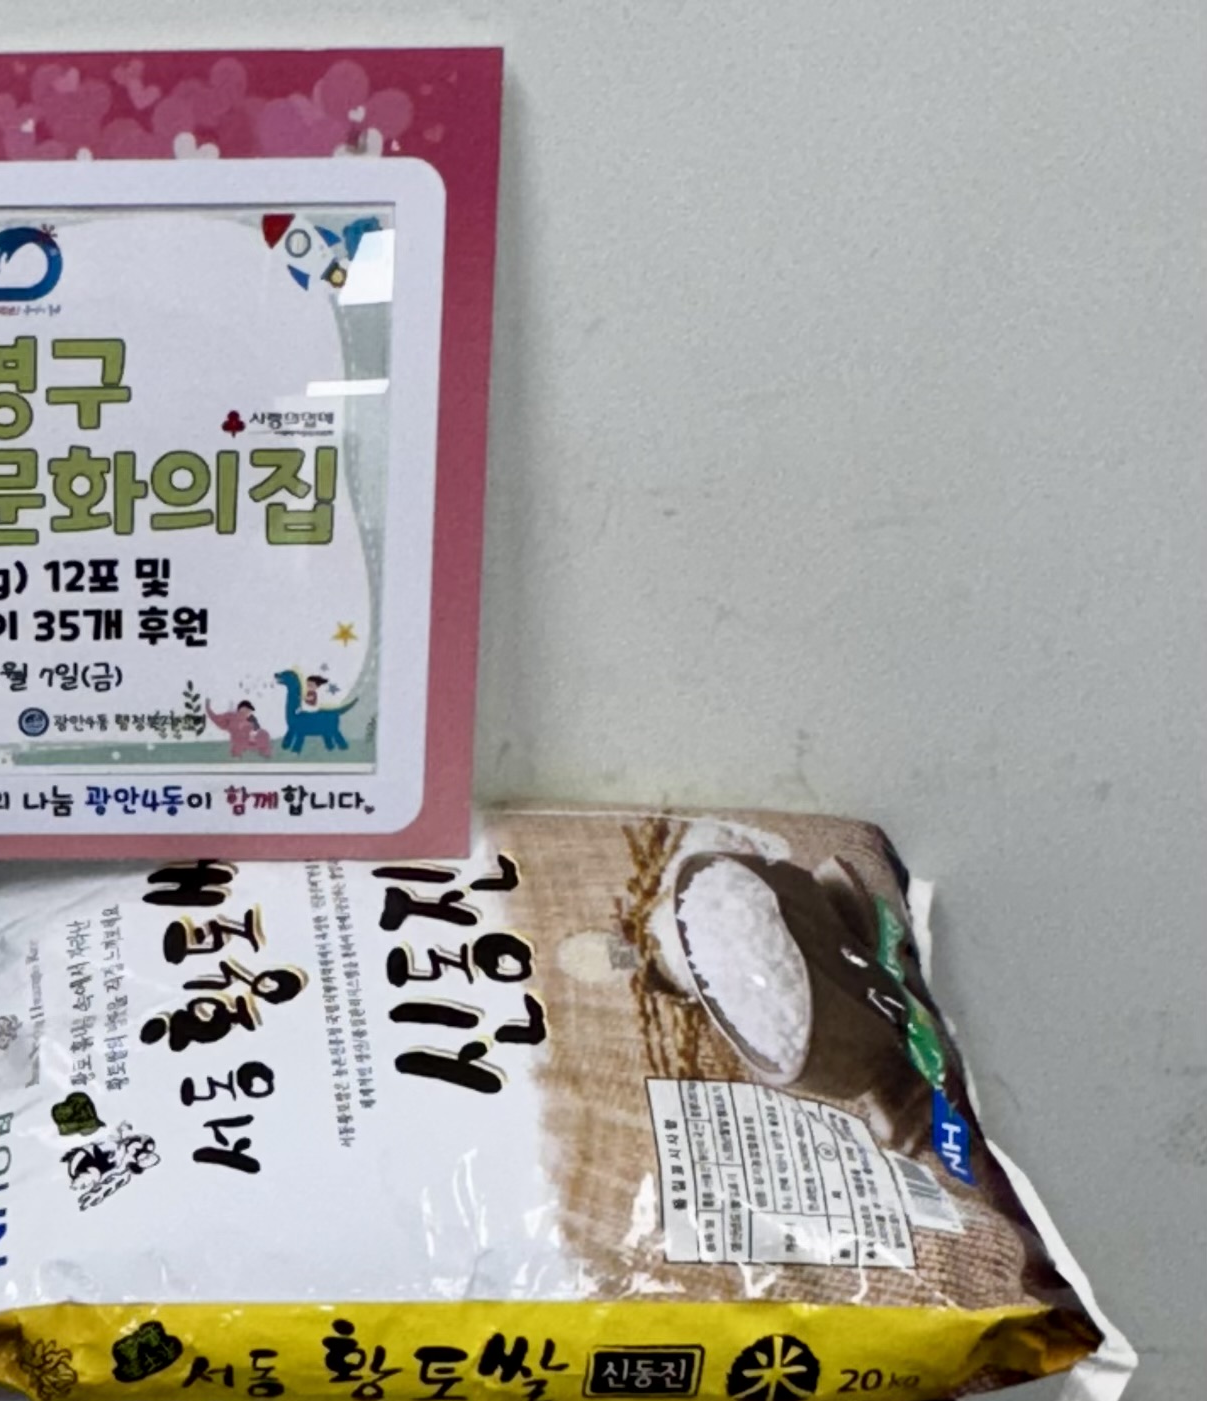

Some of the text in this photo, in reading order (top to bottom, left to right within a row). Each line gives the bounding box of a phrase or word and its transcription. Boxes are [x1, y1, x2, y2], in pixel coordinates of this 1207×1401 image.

[43, 558, 119, 594] 12포
[135, 558, 170, 599] 및
[32, 608, 123, 642] 35개
[138, 606, 208, 647] 후원
[39, 662, 123, 692] 7일(금)
[22, 785, 74, 817] 나눔
[85, 785, 211, 817] 광안4동이
[372, 851, 548, 1095] 신동진
[600, 1358, 688, 1391] 신동진
